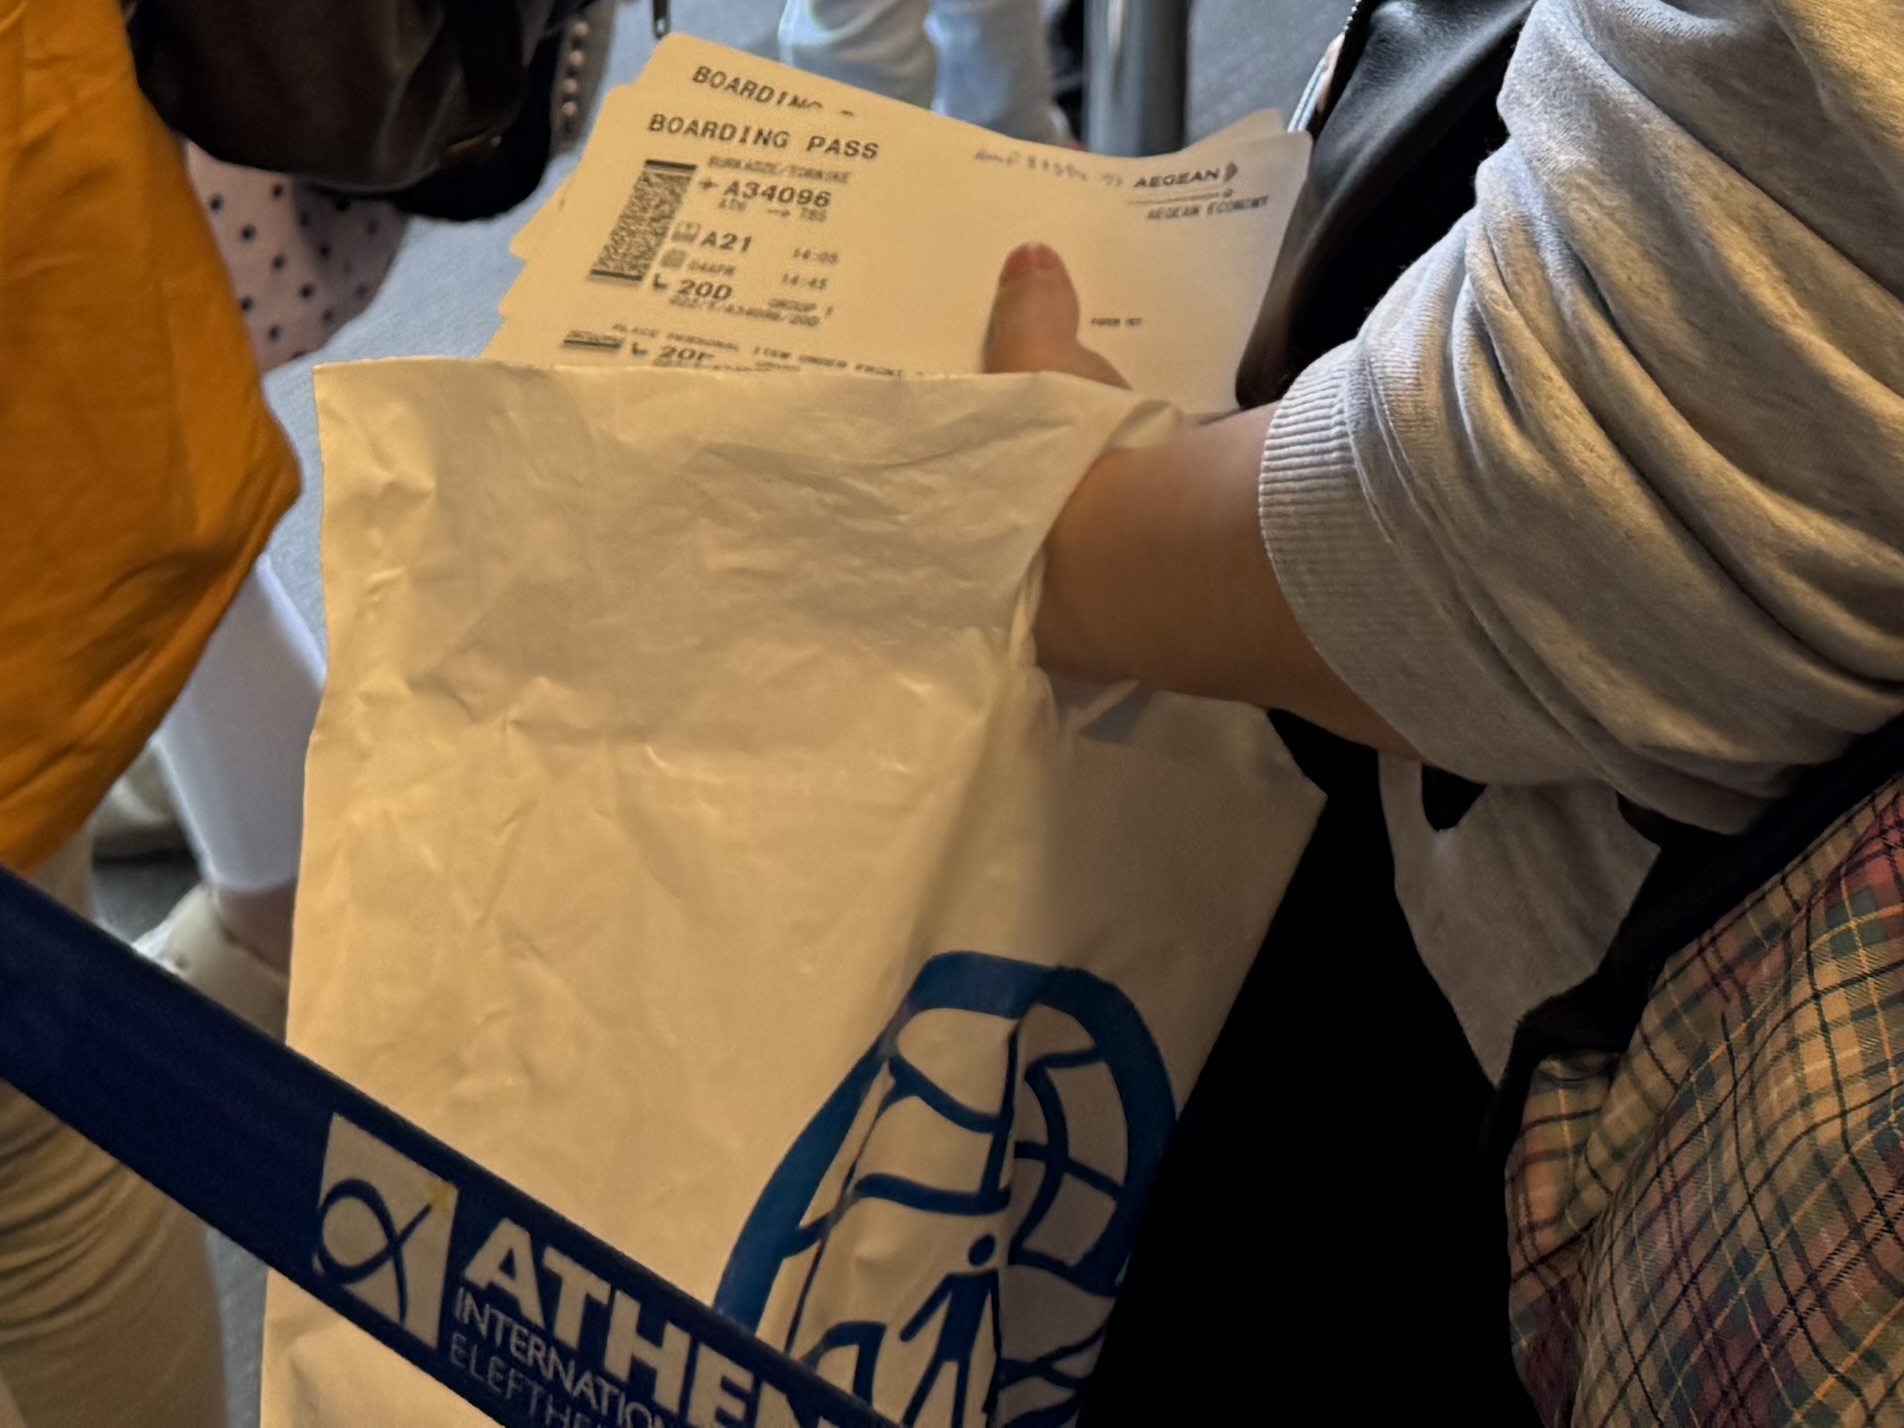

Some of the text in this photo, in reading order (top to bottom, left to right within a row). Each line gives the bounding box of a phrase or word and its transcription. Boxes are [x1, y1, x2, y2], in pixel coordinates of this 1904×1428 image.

[648, 113, 881, 159] BOARDING PASS
[1133, 168, 1220, 188] AEGEAN
[723, 180, 832, 208] A34096
[699, 231, 753, 253] A21
[676, 279, 734, 300] 20D
